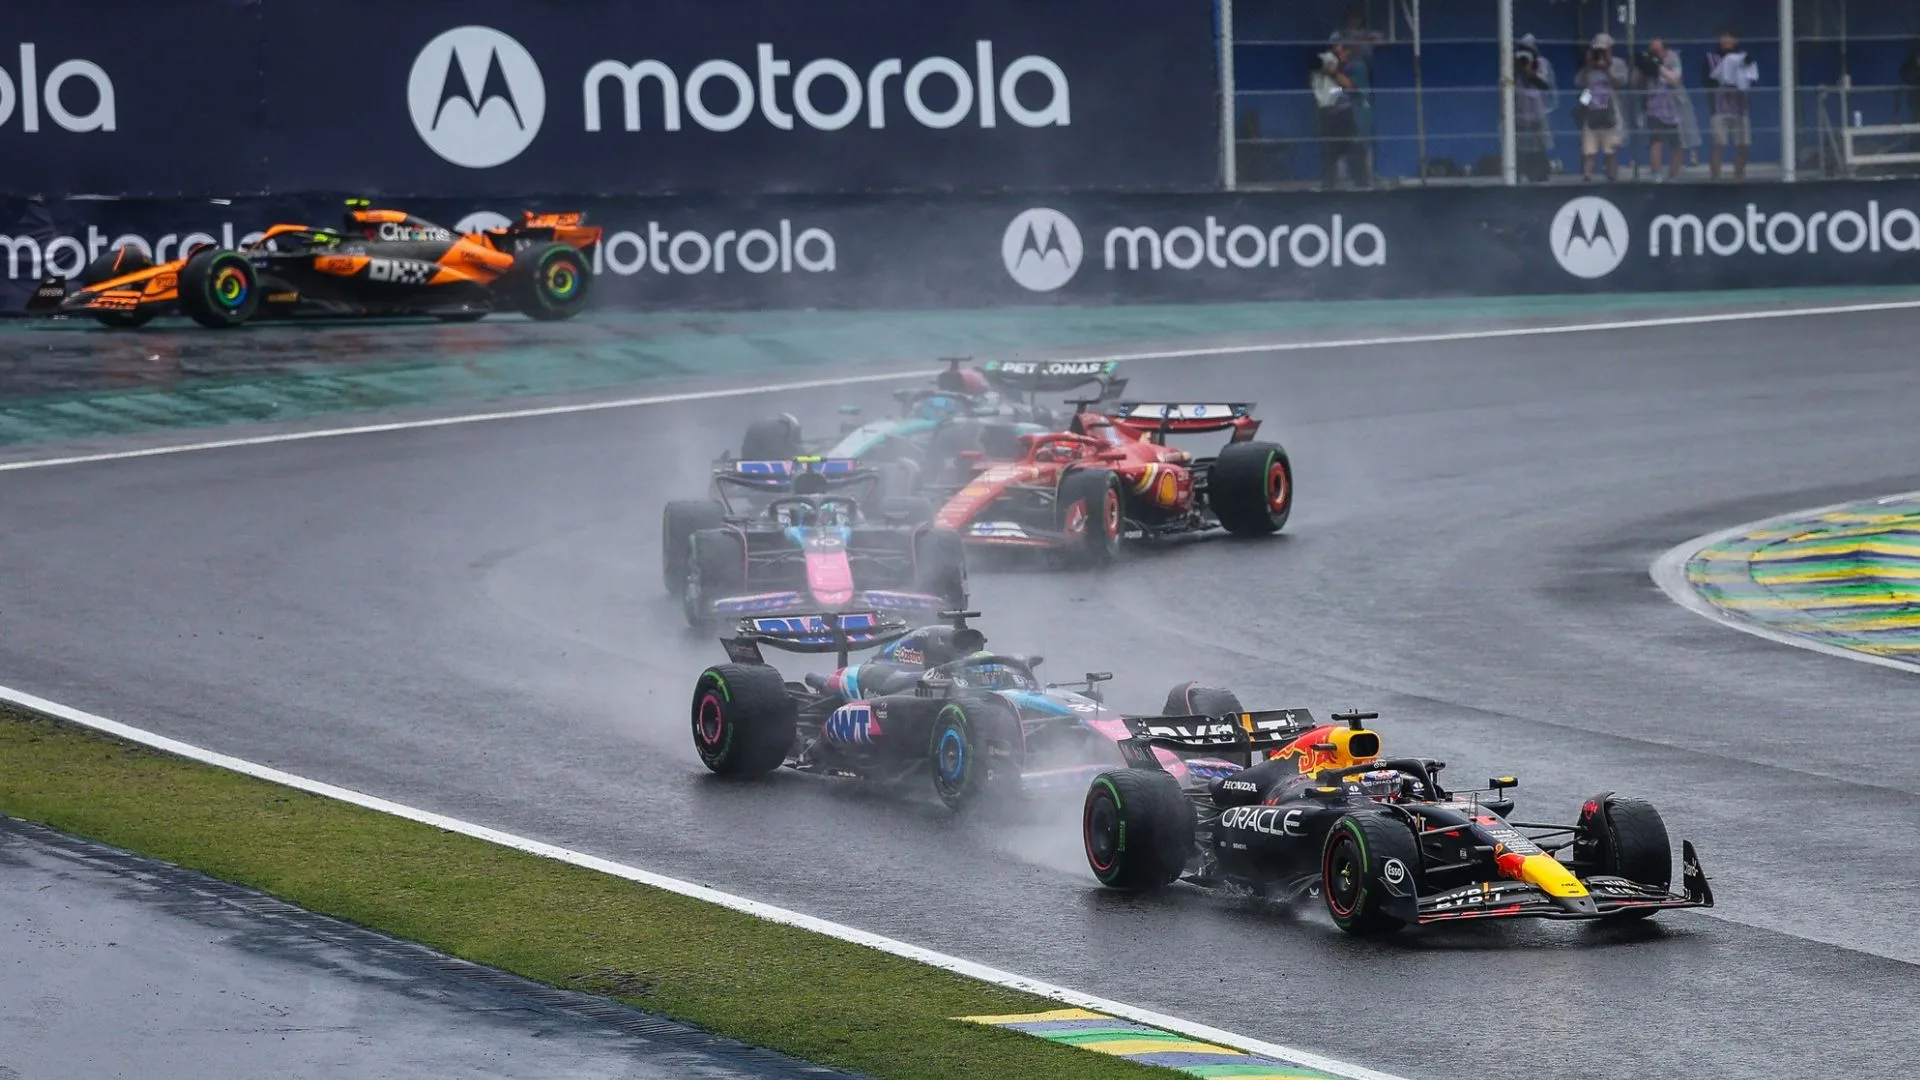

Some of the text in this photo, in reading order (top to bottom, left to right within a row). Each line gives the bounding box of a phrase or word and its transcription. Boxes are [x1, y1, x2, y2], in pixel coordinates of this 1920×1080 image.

[0, 43, 115, 132] la
[584, 40, 1070, 131] motorola
[593, 219, 836, 275] otorola
[1105, 215, 1385, 269] motorola
[1650, 200, 1920, 256] motorola
[1002, 361, 1100, 375] PETONAS
[1223, 780, 1257, 792] HONDA
[1222, 806, 1308, 837] ORACLE
[1388, 865, 1401, 877] Esso
